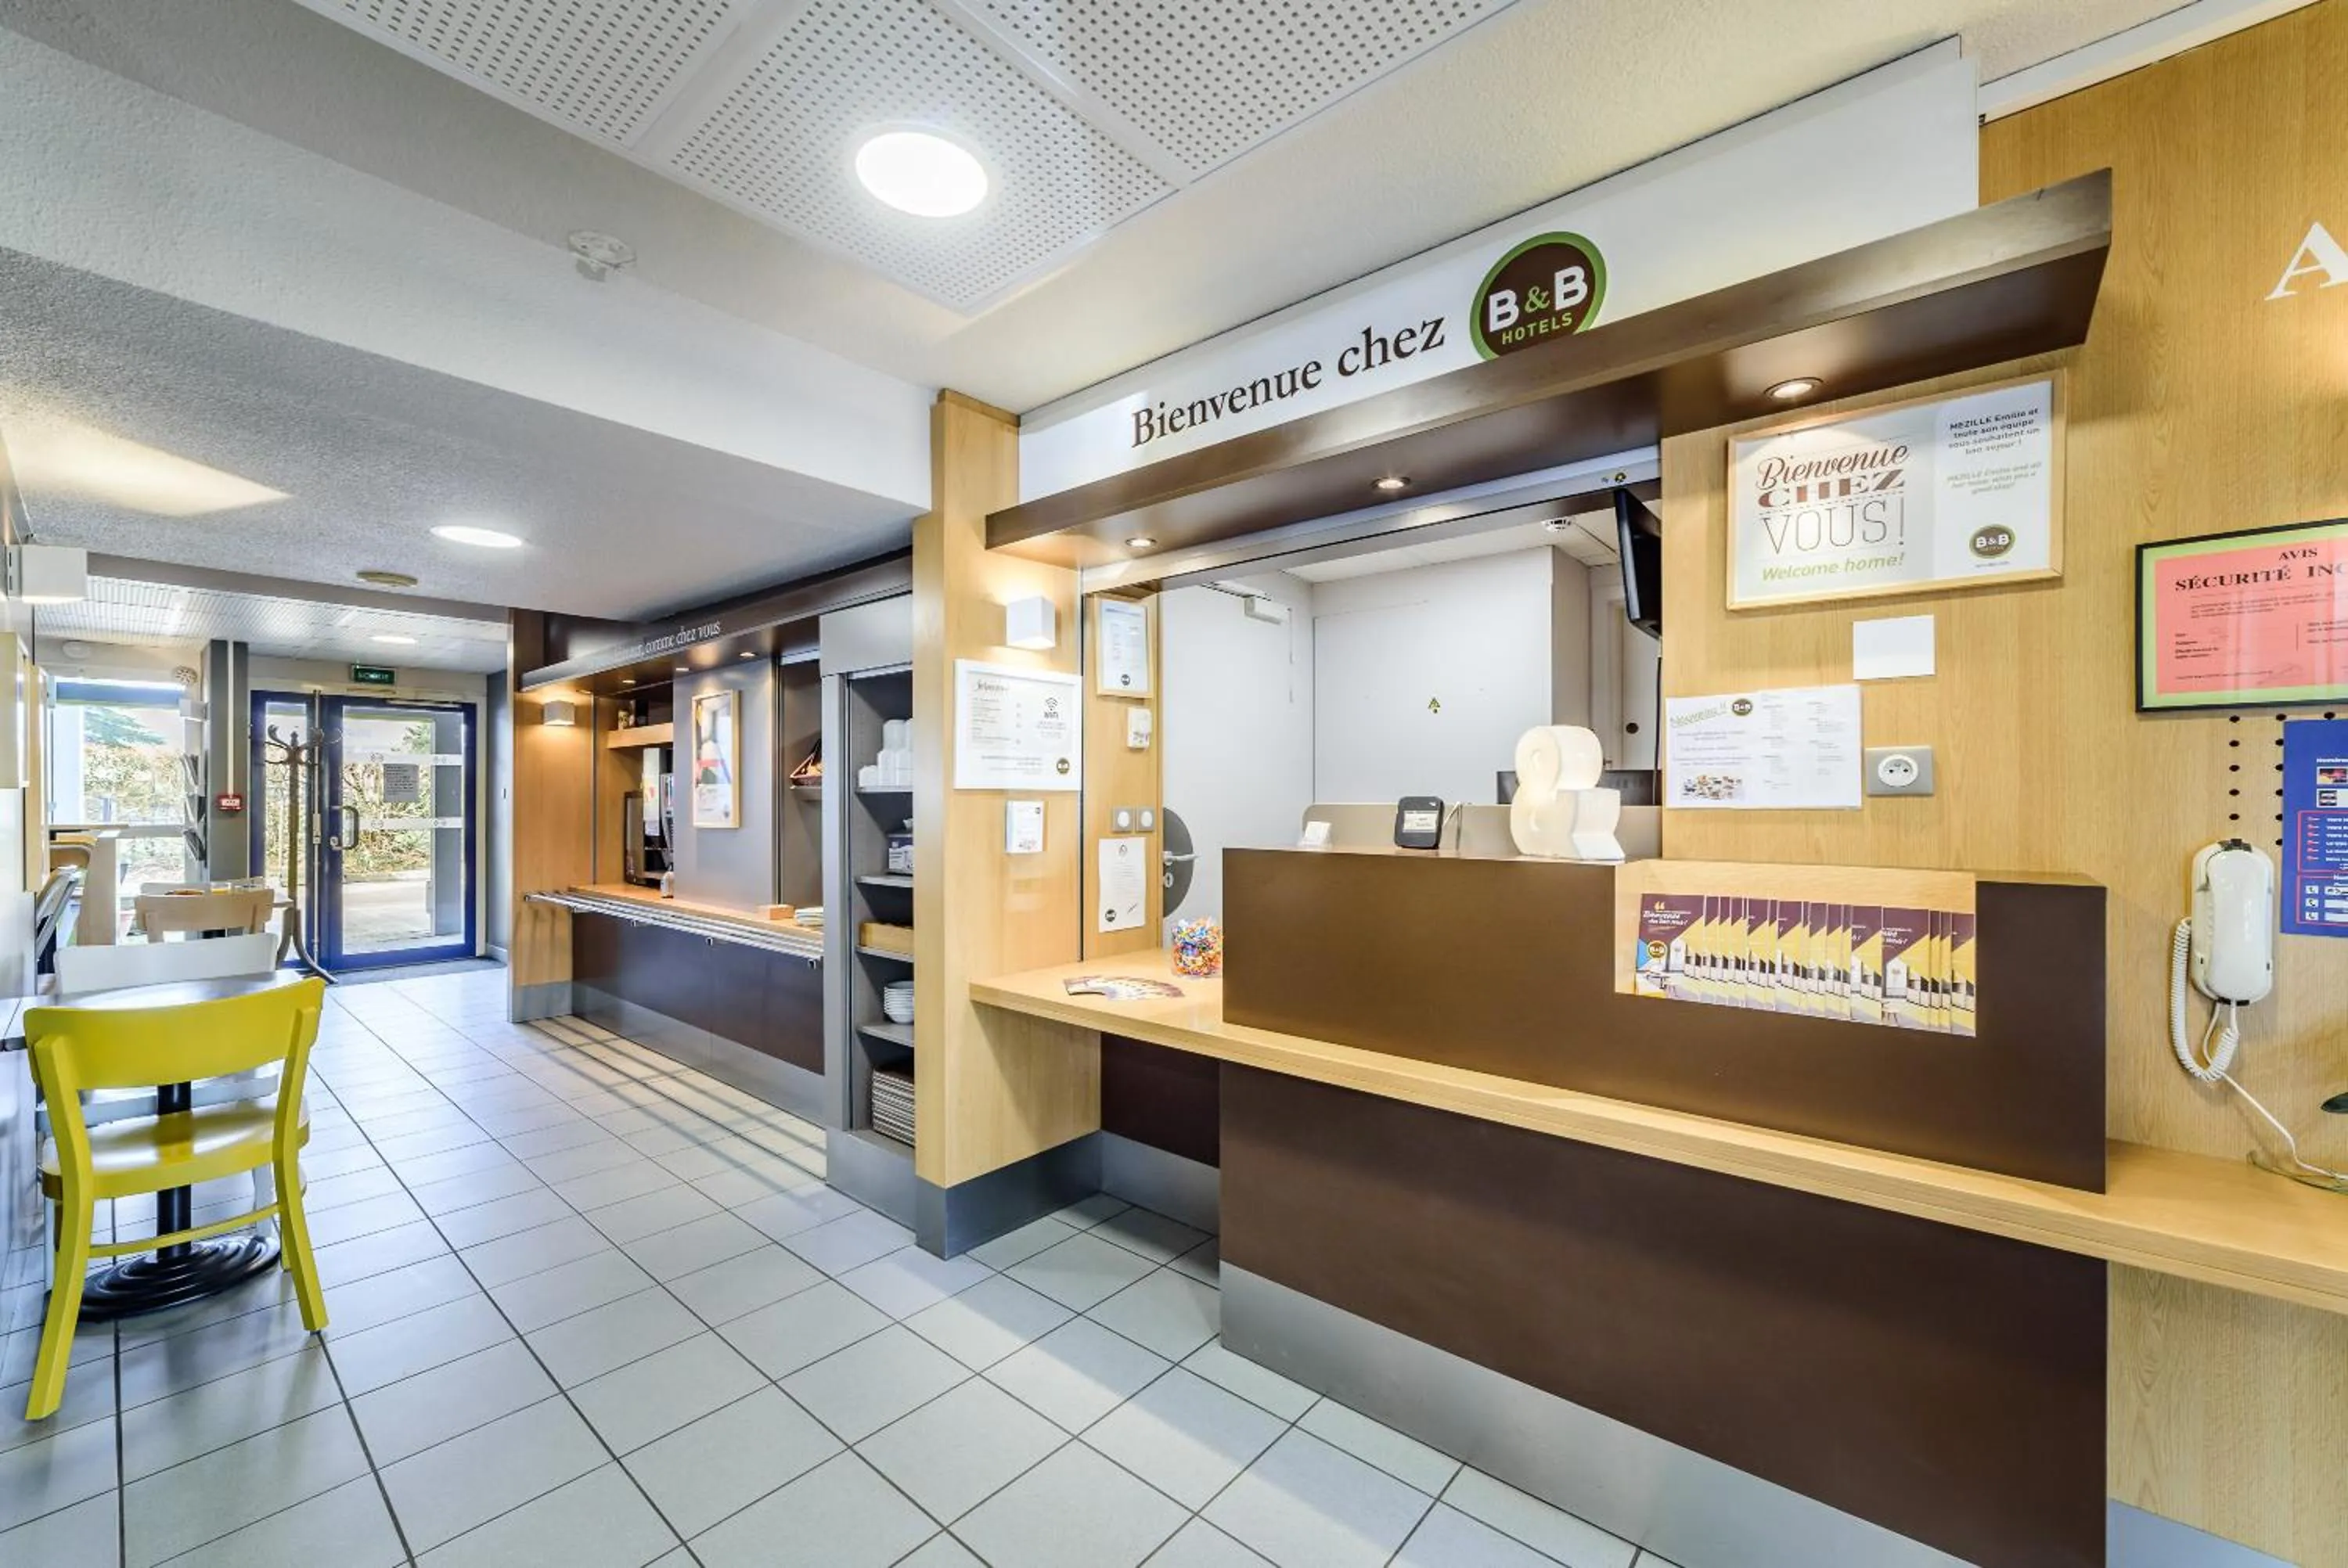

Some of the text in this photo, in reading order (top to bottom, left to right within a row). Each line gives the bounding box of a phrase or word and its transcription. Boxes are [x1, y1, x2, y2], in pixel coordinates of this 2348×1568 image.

[1488, 264, 1589, 333] B&B
[1501, 311, 1575, 345] HOTELS
[1130, 314, 1447, 448] Bienvenue chez
[1980, 425, 1999, 435] son
[1756, 444, 1910, 491] Bienvenue
[1758, 468, 1905, 509] CHEZ
[1763, 551, 1907, 581] Welcome home!
[2278, 548, 2318, 562] AVIS
[2174, 564, 2292, 592] SÉCURITÉ
